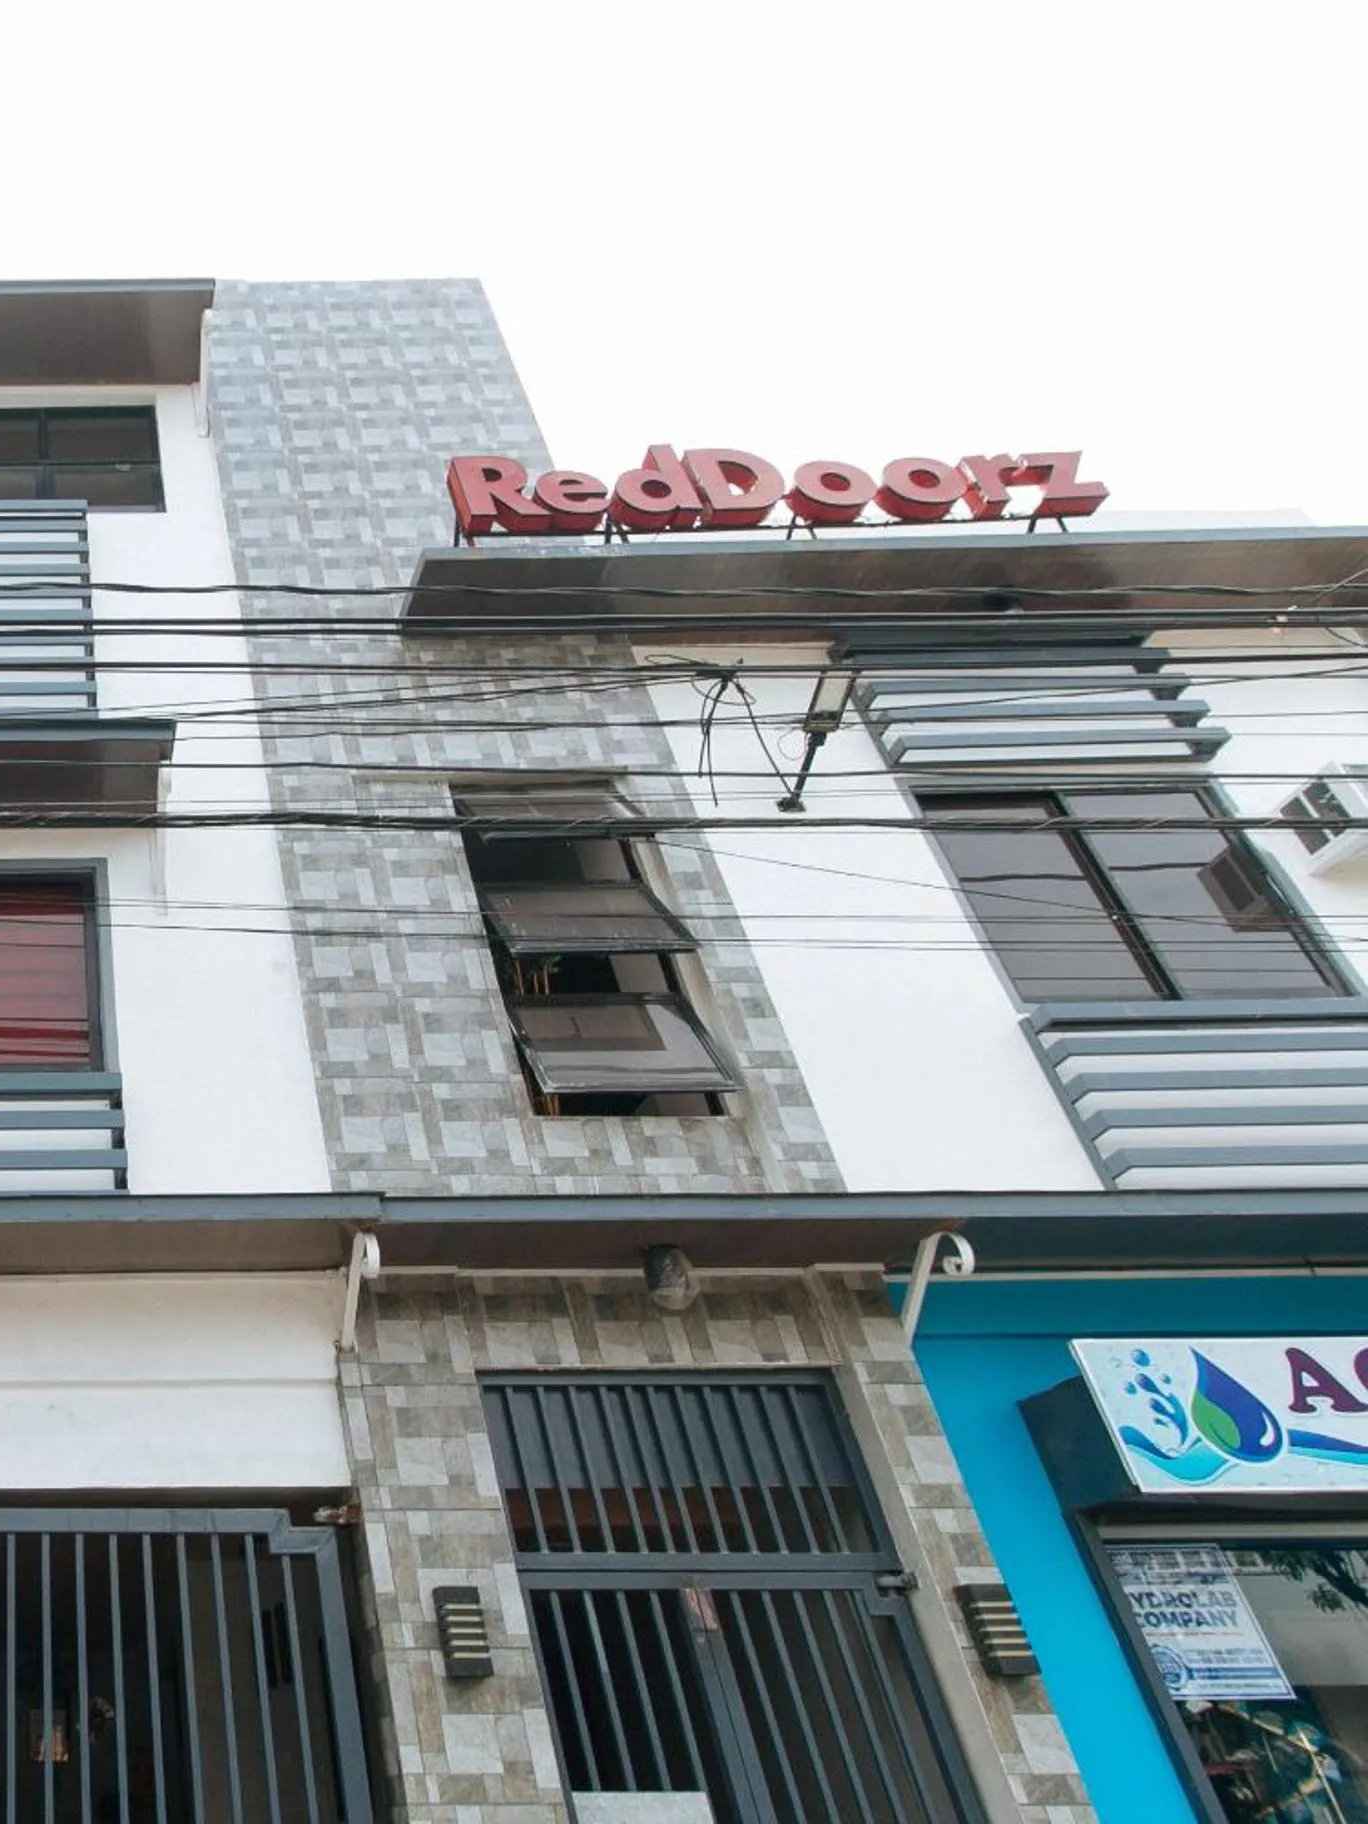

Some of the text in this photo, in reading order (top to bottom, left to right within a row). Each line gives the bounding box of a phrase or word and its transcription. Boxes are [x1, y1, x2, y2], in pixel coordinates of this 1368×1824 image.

[447, 444, 1110, 533] RedDoorz
[1285, 1347, 1368, 1413] A
[1129, 1590, 1237, 1608] YDROLAB
